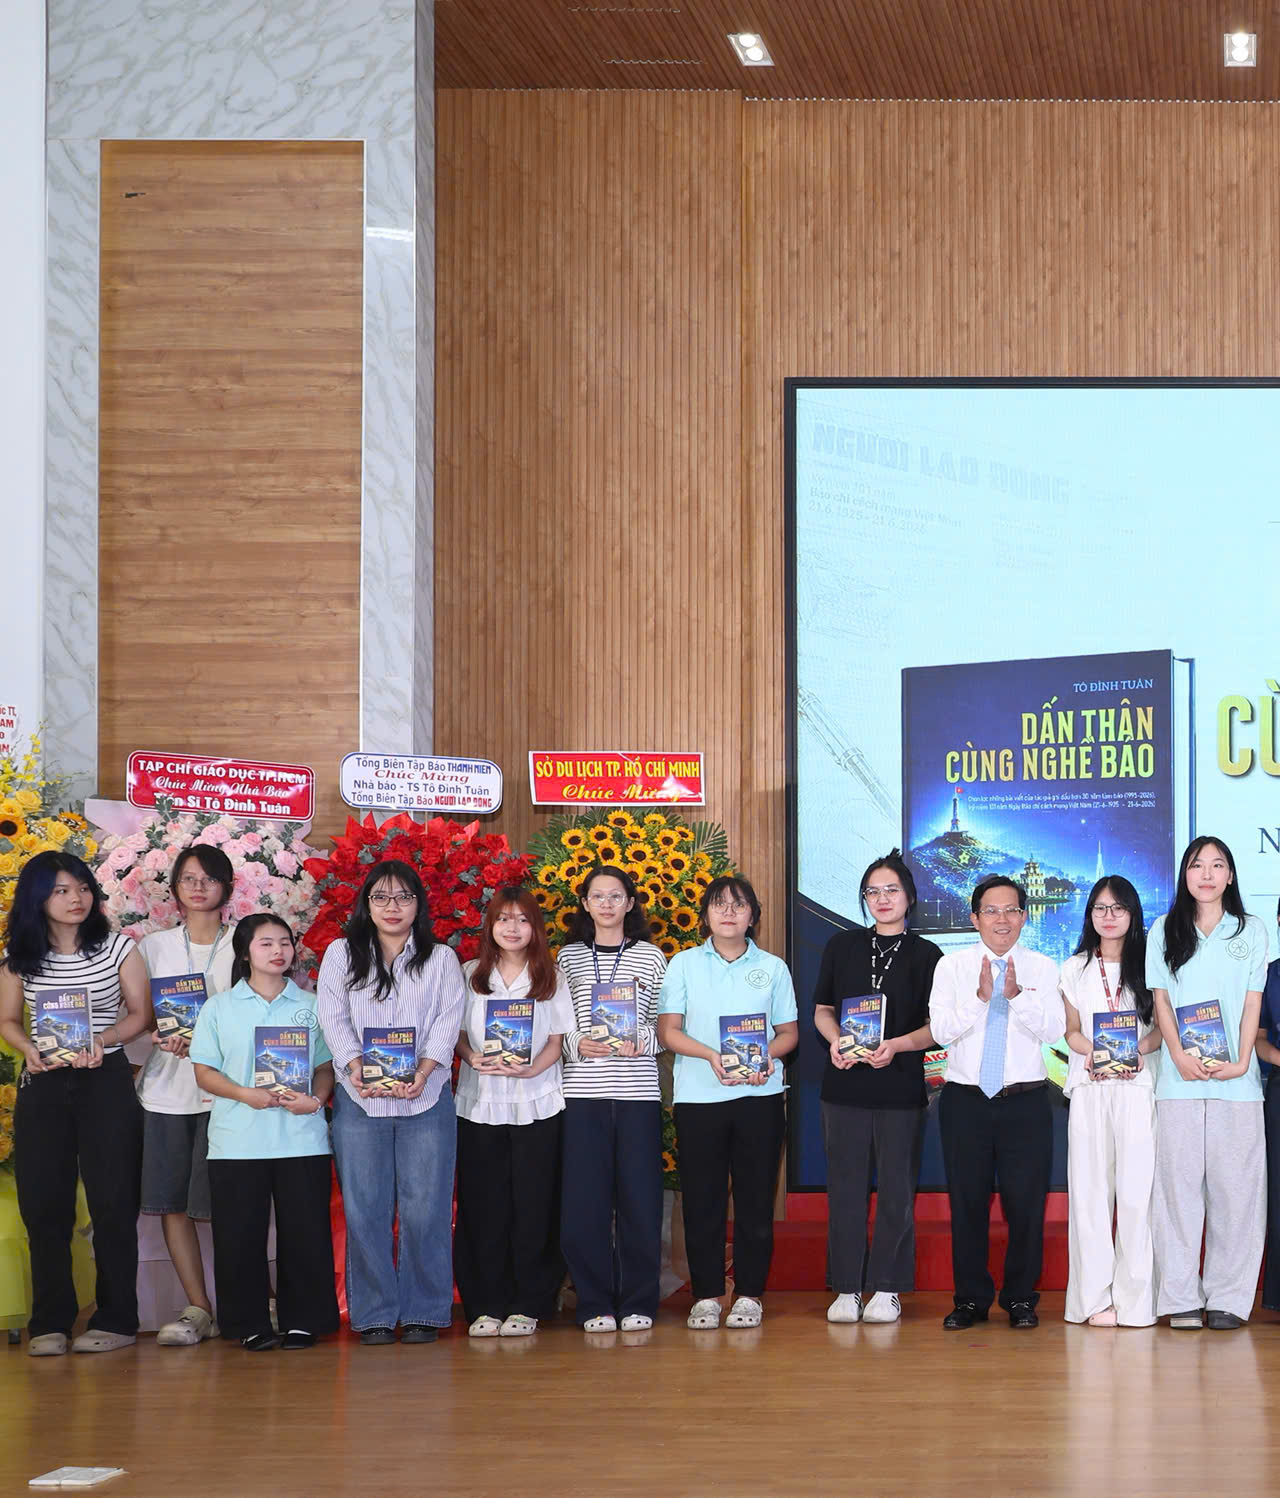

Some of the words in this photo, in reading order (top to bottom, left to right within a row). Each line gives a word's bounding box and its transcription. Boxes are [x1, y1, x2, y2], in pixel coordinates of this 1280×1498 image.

[1073, 682, 1088, 693] TÔ
[1089, 680, 1118, 693] ĐÌNH
[1121, 678, 1154, 691] TUÂN
[1021, 695, 1074, 746] DẤN
[1080, 698, 1154, 743] THÂN
[356, 756, 380, 770] Tổng
[383, 758, 404, 770] Biên
[407, 759, 425, 773] Tập
[428, 761, 446, 772] Báo
[536, 755, 554, 778] SỞ
[556, 761, 574, 778] DU
[577, 761, 603, 781] LỊCH
[605, 761, 622, 778] TP.
[624, 756, 643, 778] HỒ
[645, 758, 666, 778] CHÍ
[669, 761, 700, 778] MINH
[945, 740, 1015, 784] CÙNG
[1022, 735, 1095, 782] NGHỀ
[1100, 735, 1155, 779] BÁO
[138, 760, 164, 775] TẠP
[166, 761, 191, 774] CHÍ
[194, 763, 226, 777] GIÁO
[229, 768, 257, 781] DỤC
[374, 769, 415, 780] Chúc
[421, 772, 469, 785] Mừng
[155, 776, 187, 790] Chúc
[228, 782, 259, 796] Nhà
[263, 785, 291, 798] Báo
[353, 780, 374, 790] Nhà
[378, 780, 396, 791] báo
[406, 782, 420, 792] TS
[422, 783, 435, 793] Tô
[438, 784, 462, 795] Đình
[464, 785, 490, 796] Tuân
[562, 784, 615, 800] Chúc
[204, 796, 220, 810] Tô
[224, 797, 256, 812] Đình
[258, 800, 291, 815] Tuân
[351, 791, 374, 804] Tổng
[376, 793, 396, 804] Biên
[398, 794, 414, 807] Tập
[416, 795, 433, 806] Báo
